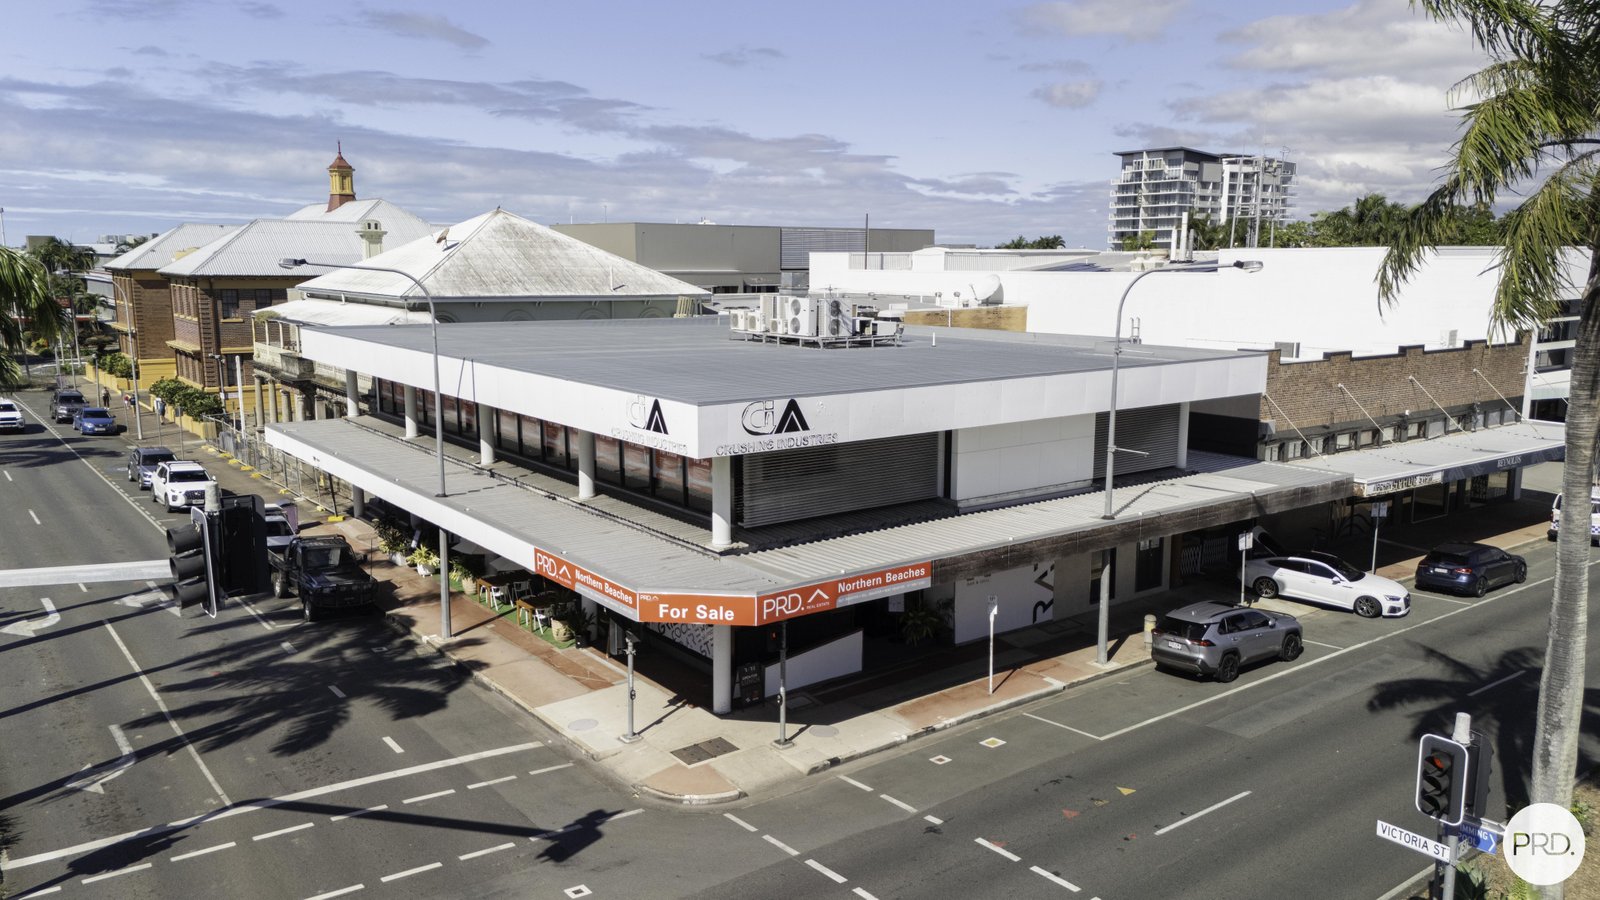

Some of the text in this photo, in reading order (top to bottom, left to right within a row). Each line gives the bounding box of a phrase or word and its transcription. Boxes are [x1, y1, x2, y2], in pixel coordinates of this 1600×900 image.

[610, 426, 688, 455] CRUSHING INDUSTRIES
[715, 433, 838, 456] CRUSHING INDUSTRIES
[574, 569, 603, 591] Northern
[604, 582, 633, 605] Beaches
[838, 577, 882, 594] Northern
[885, 566, 926, 584] Beaches
[658, 603, 735, 621] For Sale
[1380, 823, 1429, 852] VICTORIA
[1433, 845, 1447, 857] ST
[1459, 824, 1489, 841] IMMING
